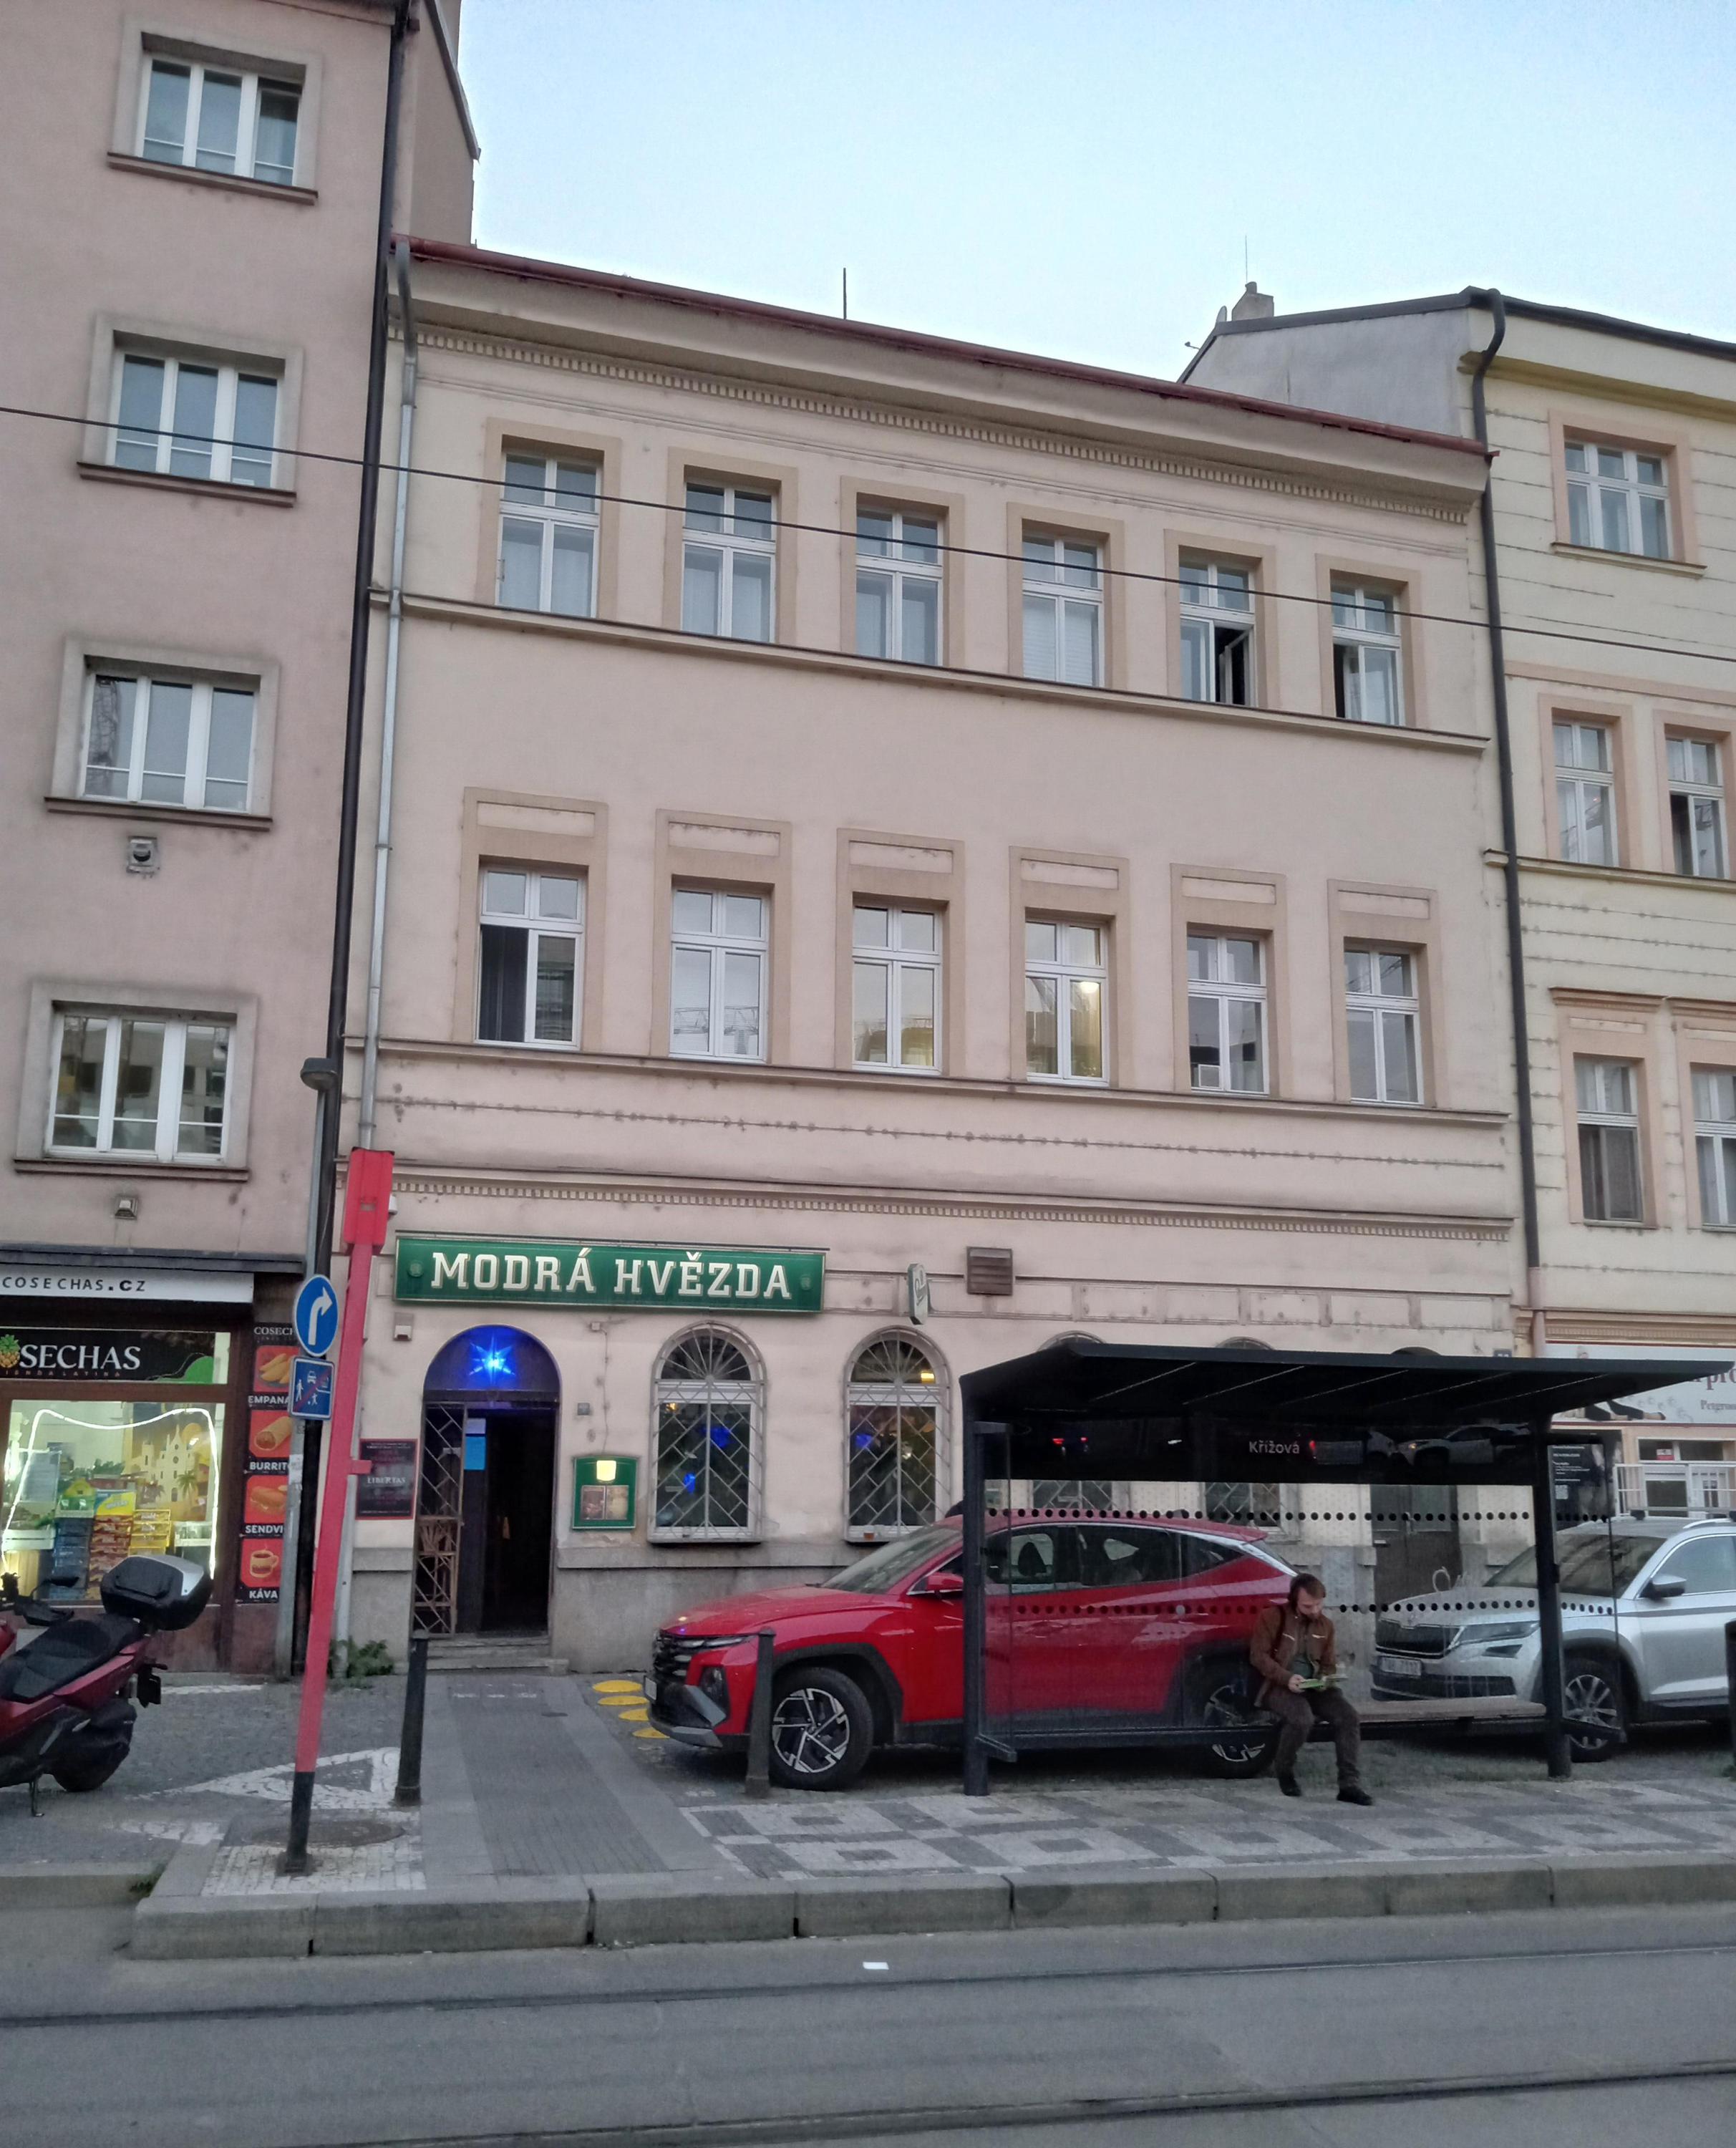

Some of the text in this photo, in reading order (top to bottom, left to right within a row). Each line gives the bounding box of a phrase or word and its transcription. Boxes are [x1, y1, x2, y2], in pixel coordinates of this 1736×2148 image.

[431, 1247, 792, 1300] MODRÁ HVĚZDA
[2, 1277, 146, 1292] COSECHAS.CZ
[1248, 1440, 1300, 1453] Křížová
[250, 1461, 289, 1471] BURRIT
[249, 1589, 278, 1599] KÁVA
